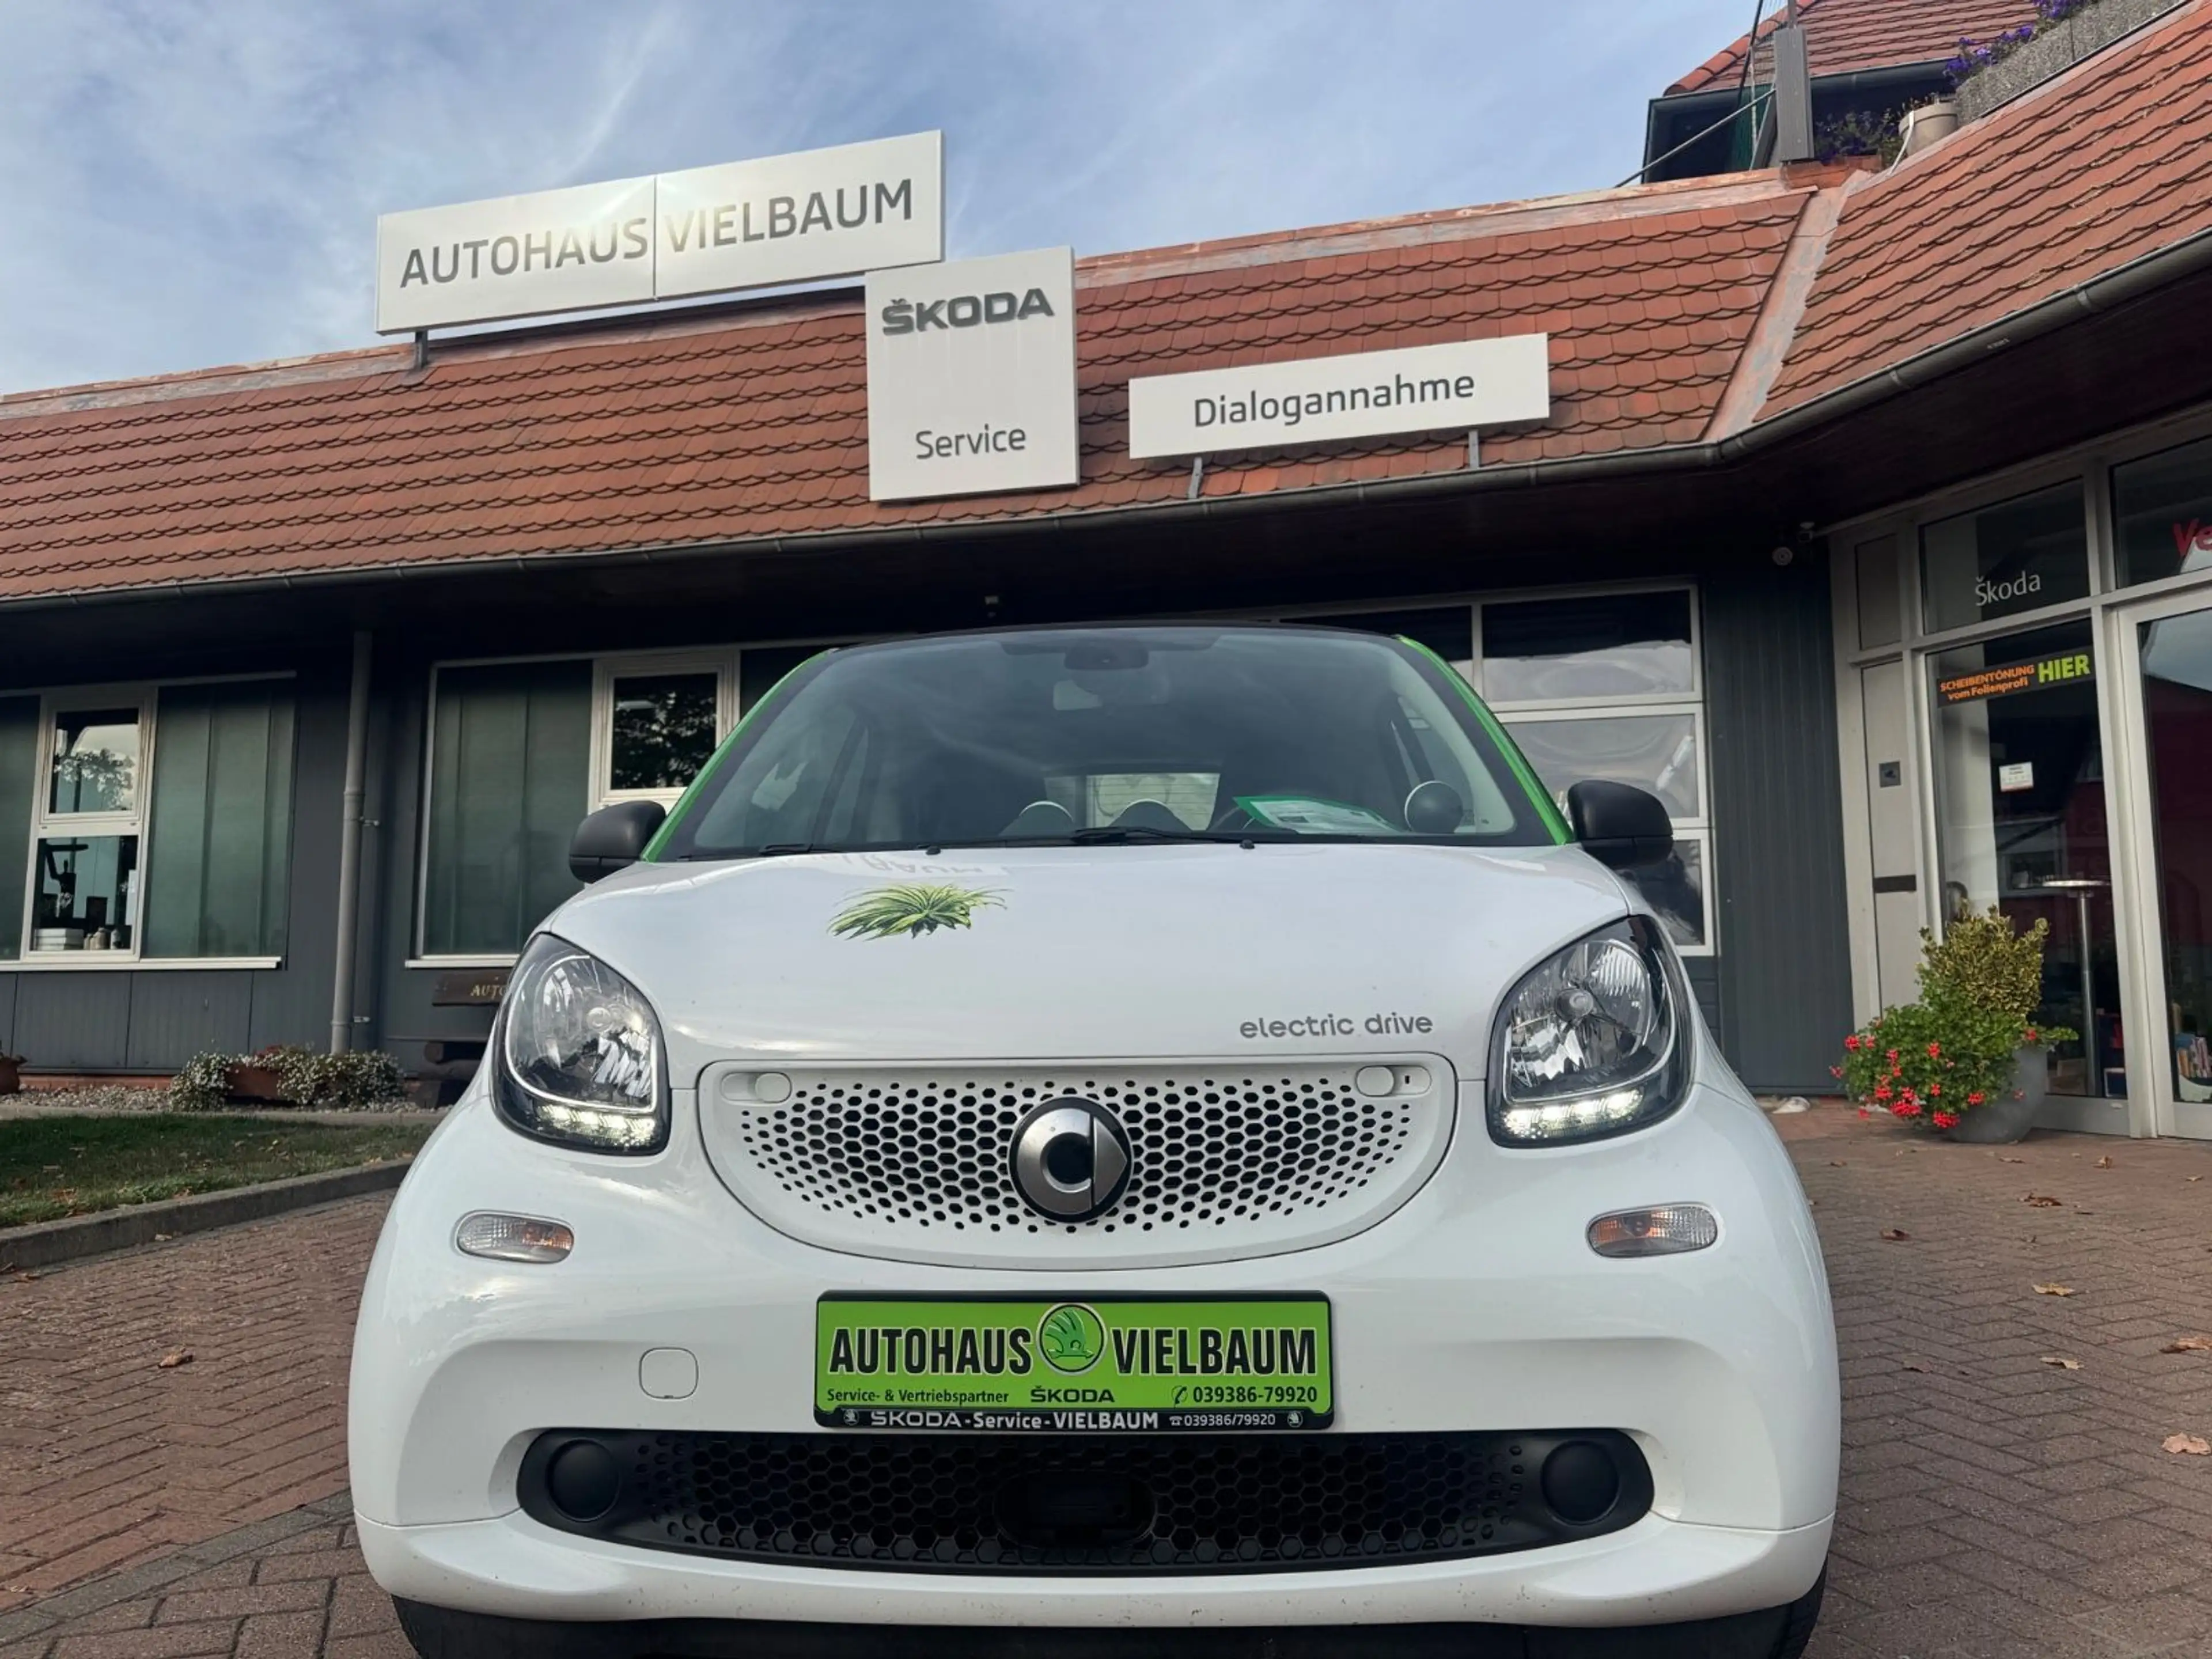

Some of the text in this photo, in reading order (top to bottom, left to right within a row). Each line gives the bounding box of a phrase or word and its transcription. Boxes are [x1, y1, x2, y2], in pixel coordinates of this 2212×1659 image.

[400, 179, 911, 289] AUTOHAUS VIELBAUM
[881, 286, 1054, 336] ŠKODA
[1194, 374, 1475, 427] Dialogannahme
[915, 423, 1027, 460] Service
[1974, 570, 2041, 607] Škoda
[2037, 654, 2090, 683] HIER
[1948, 677, 2028, 701] vom Folienprofi
[1240, 1012, 1433, 1038] electric drive
[828, 1327, 1317, 1375] AUTOHAUS VIELBAUM
[827, 1388, 1009, 1406] Service- & Vertriebspartner
[1031, 1385, 1115, 1403] ŠKODA
[1193, 1386, 1317, 1403] 039386-79920
[1184, 1414, 1275, 1426] 039386/79920
